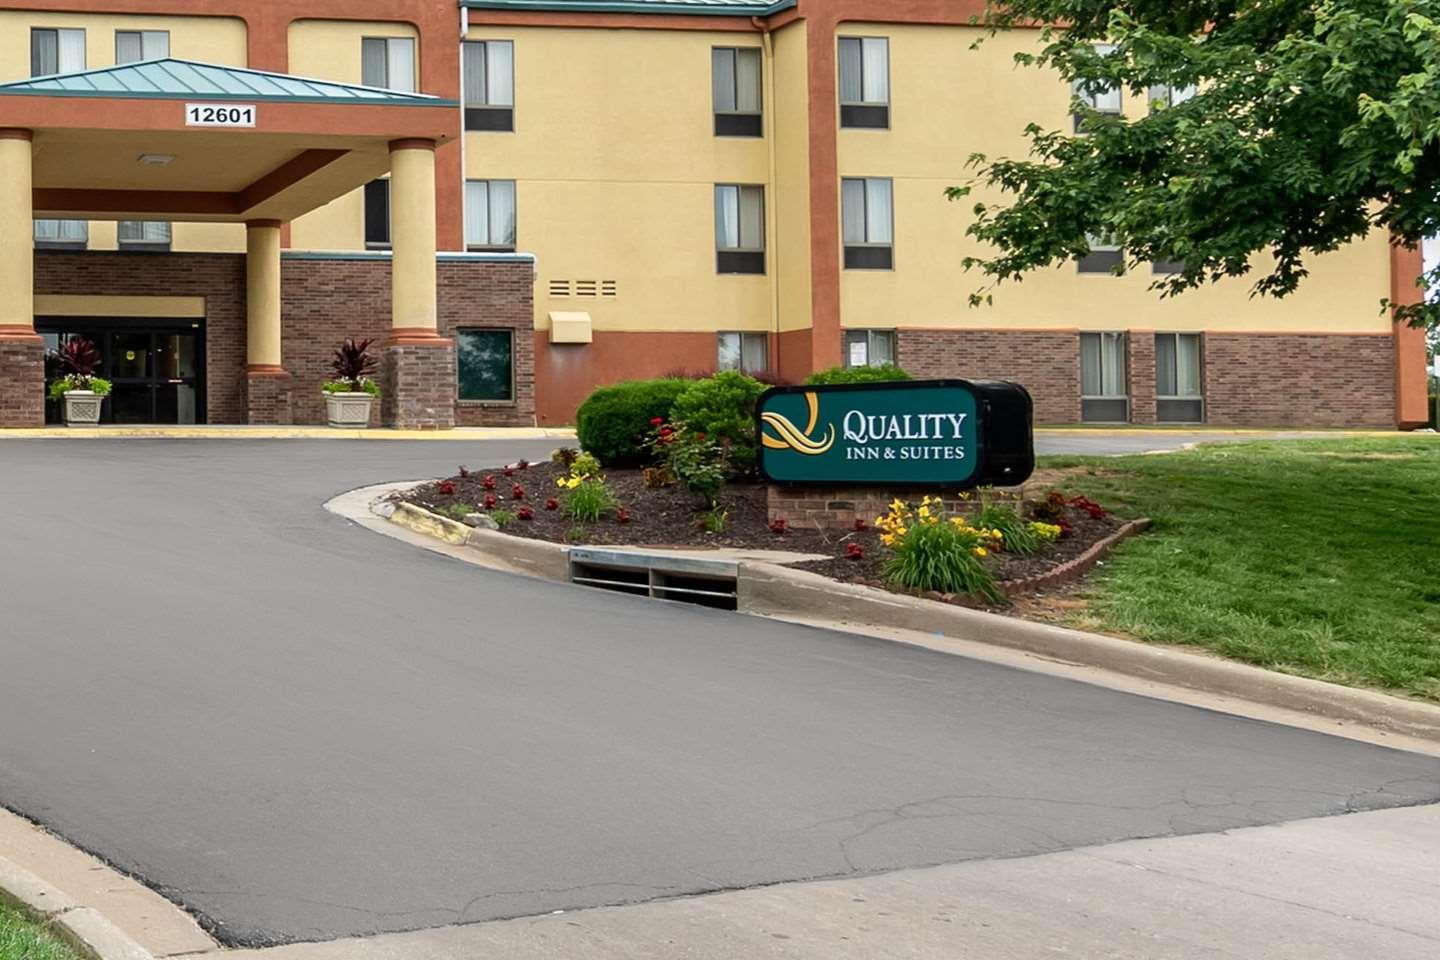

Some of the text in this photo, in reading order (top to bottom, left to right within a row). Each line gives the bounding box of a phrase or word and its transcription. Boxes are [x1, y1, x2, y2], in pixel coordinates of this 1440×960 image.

[190, 107, 252, 123] 12601
[843, 410, 967, 444] QUALITY
[846, 446, 965, 460] INN & SUITES
